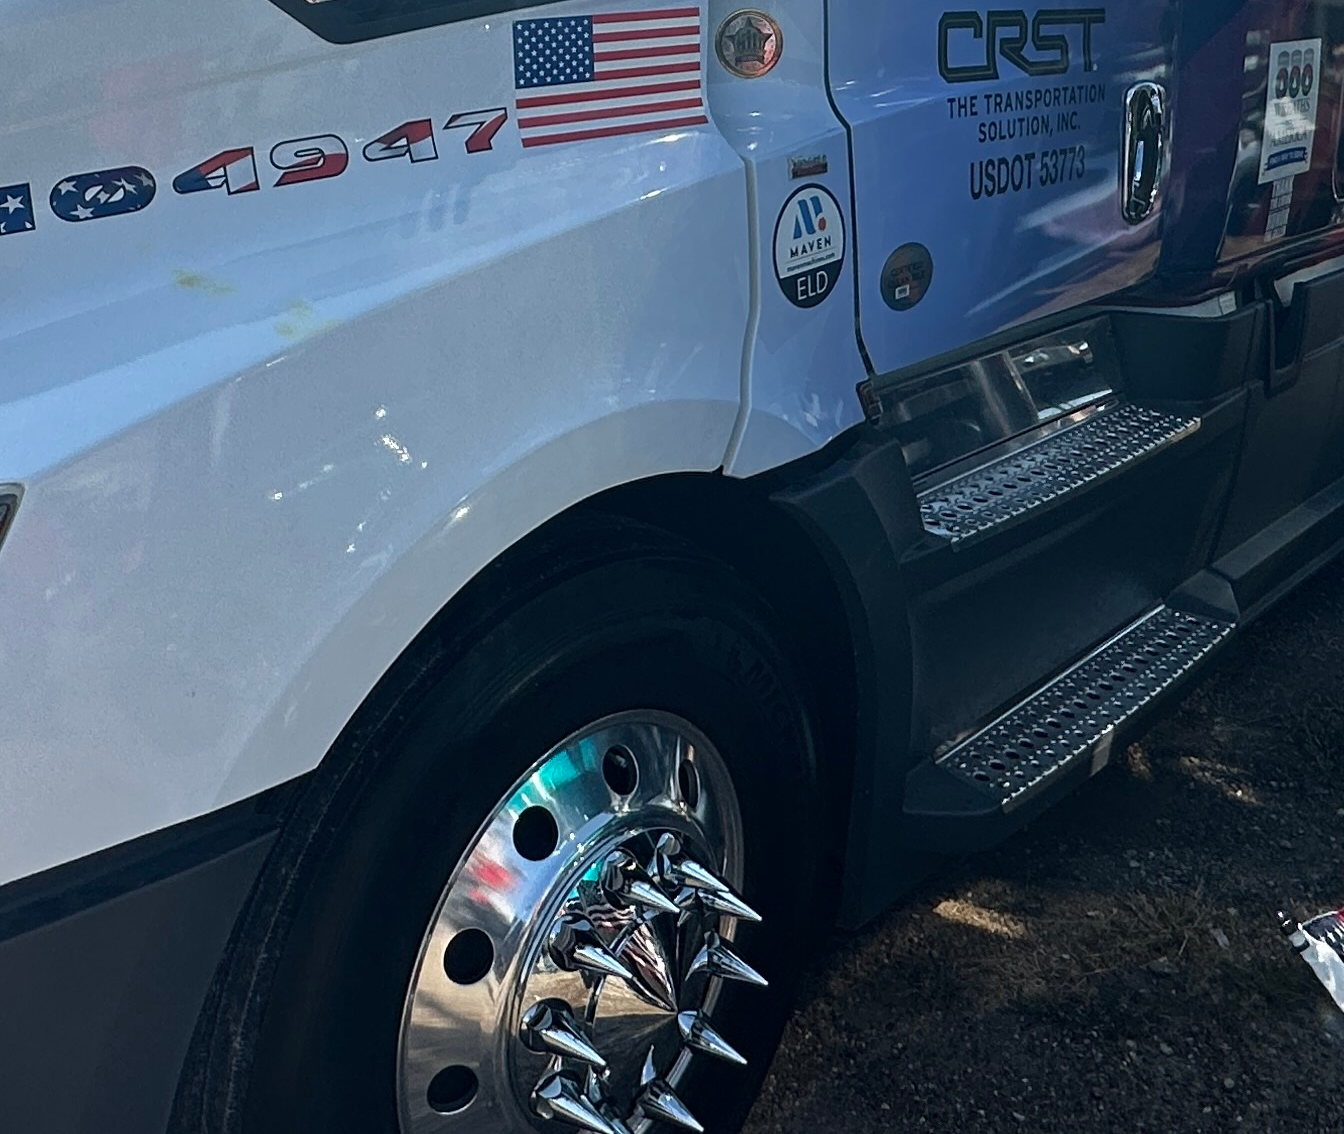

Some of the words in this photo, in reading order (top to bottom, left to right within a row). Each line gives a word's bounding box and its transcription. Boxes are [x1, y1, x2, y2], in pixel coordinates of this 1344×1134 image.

[937, 8, 1106, 83] CRST
[947, 95, 979, 119] THE
[983, 83, 1106, 115] TRANSPORTATION
[977, 115, 1054, 144] SOLUTION,
[1056, 111, 1081, 134] INC.
[969, 152, 1036, 200] USDOT
[1039, 144, 1086, 186] 53773
[789, 235, 832, 259] MAVEN
[796, 270, 829, 301] ELD
